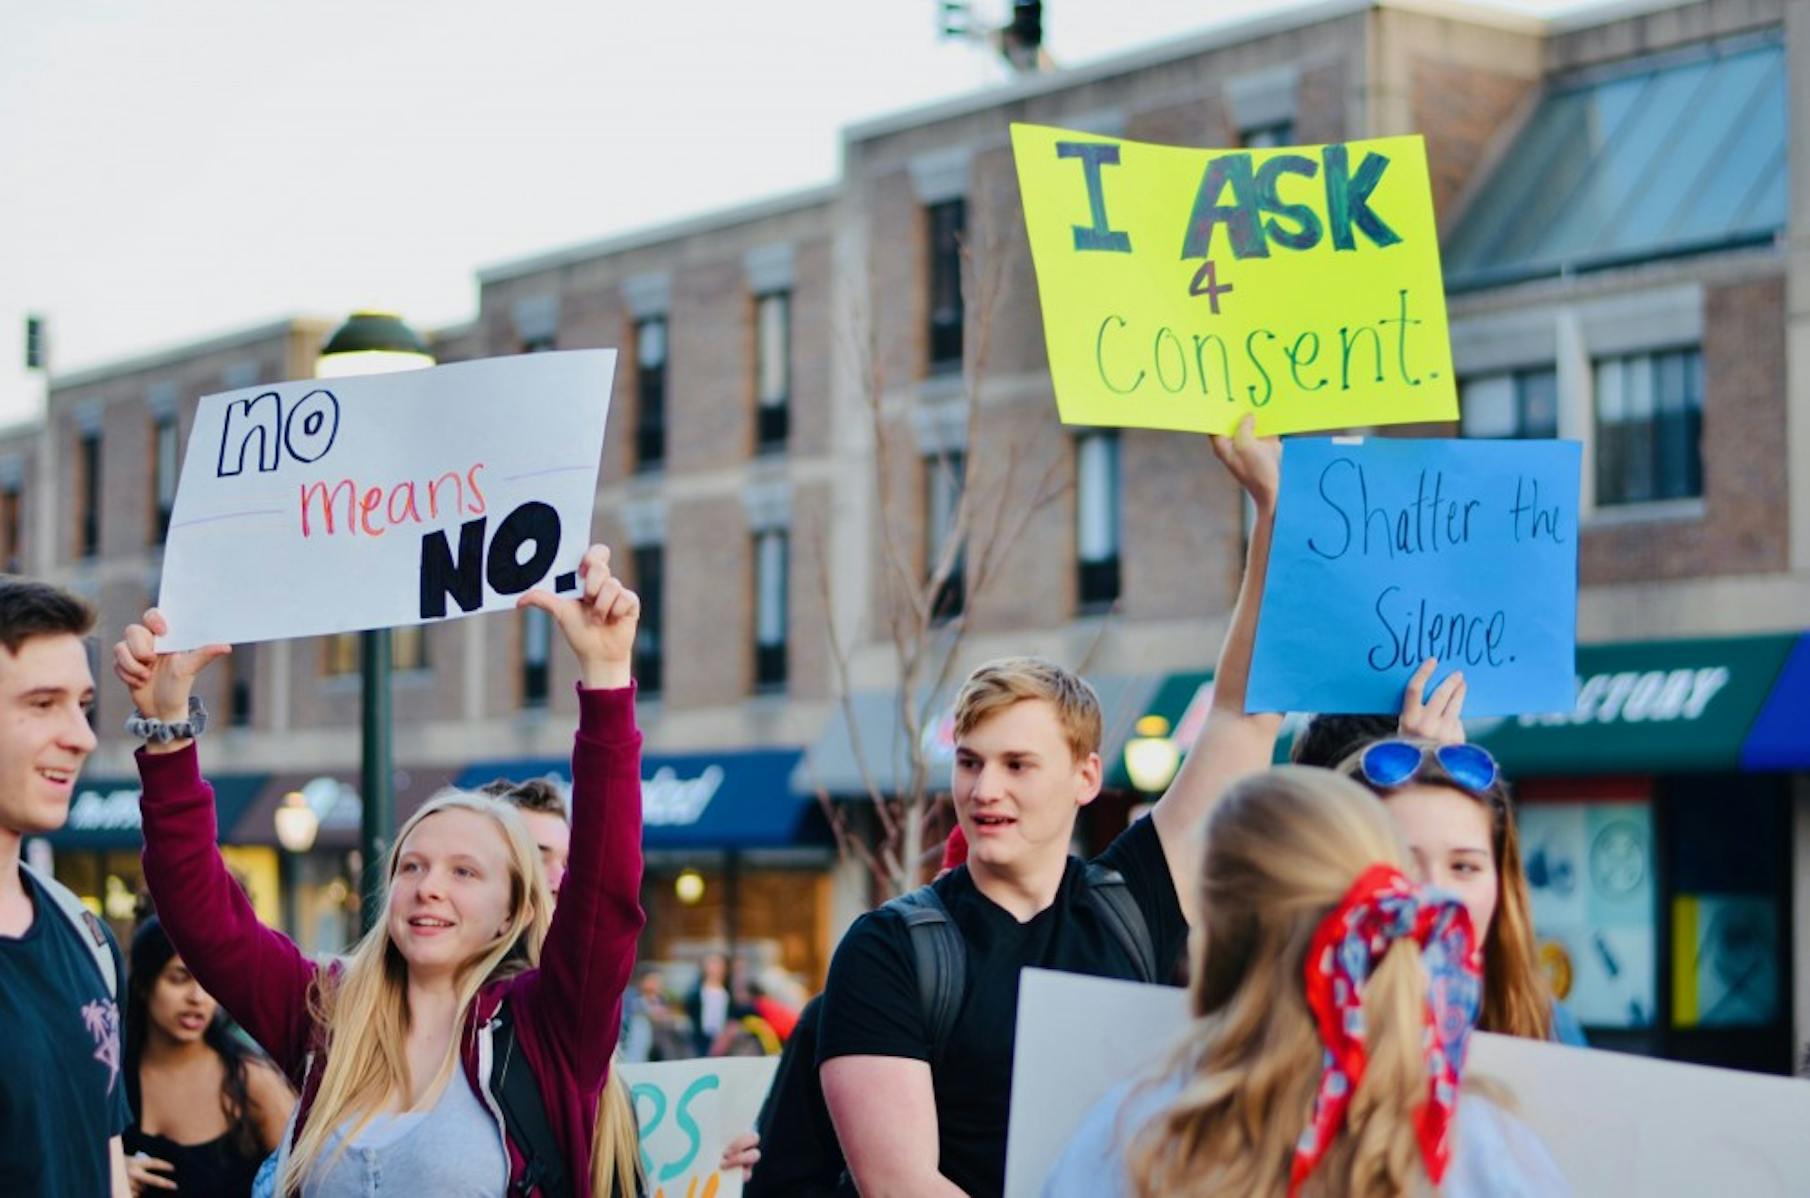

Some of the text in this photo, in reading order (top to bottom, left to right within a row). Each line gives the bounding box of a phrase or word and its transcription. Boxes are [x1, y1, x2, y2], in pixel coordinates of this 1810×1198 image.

[1055, 141, 1404, 260] I ASK
[1188, 260, 1234, 315] 4
[300, 462, 488, 538] means
[1307, 457, 1565, 560] Shatter the
[419, 500, 577, 619] NO.
[1367, 585, 1516, 672] Silence.
